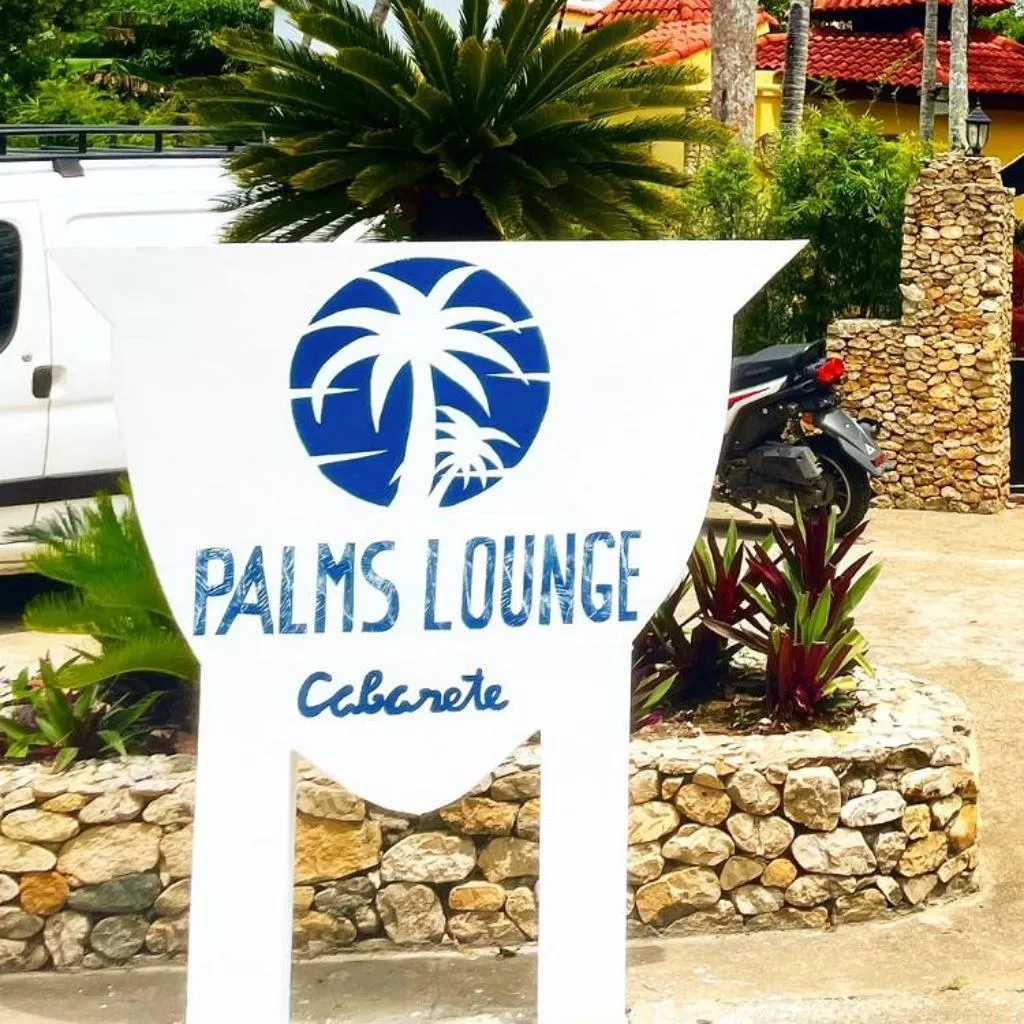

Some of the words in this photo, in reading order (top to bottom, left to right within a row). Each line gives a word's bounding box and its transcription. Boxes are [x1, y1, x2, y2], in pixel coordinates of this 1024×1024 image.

[194, 542, 399, 636] PALMS
[424, 531, 641, 631] LOUNGE
[297, 668, 508, 717] Cabarete
